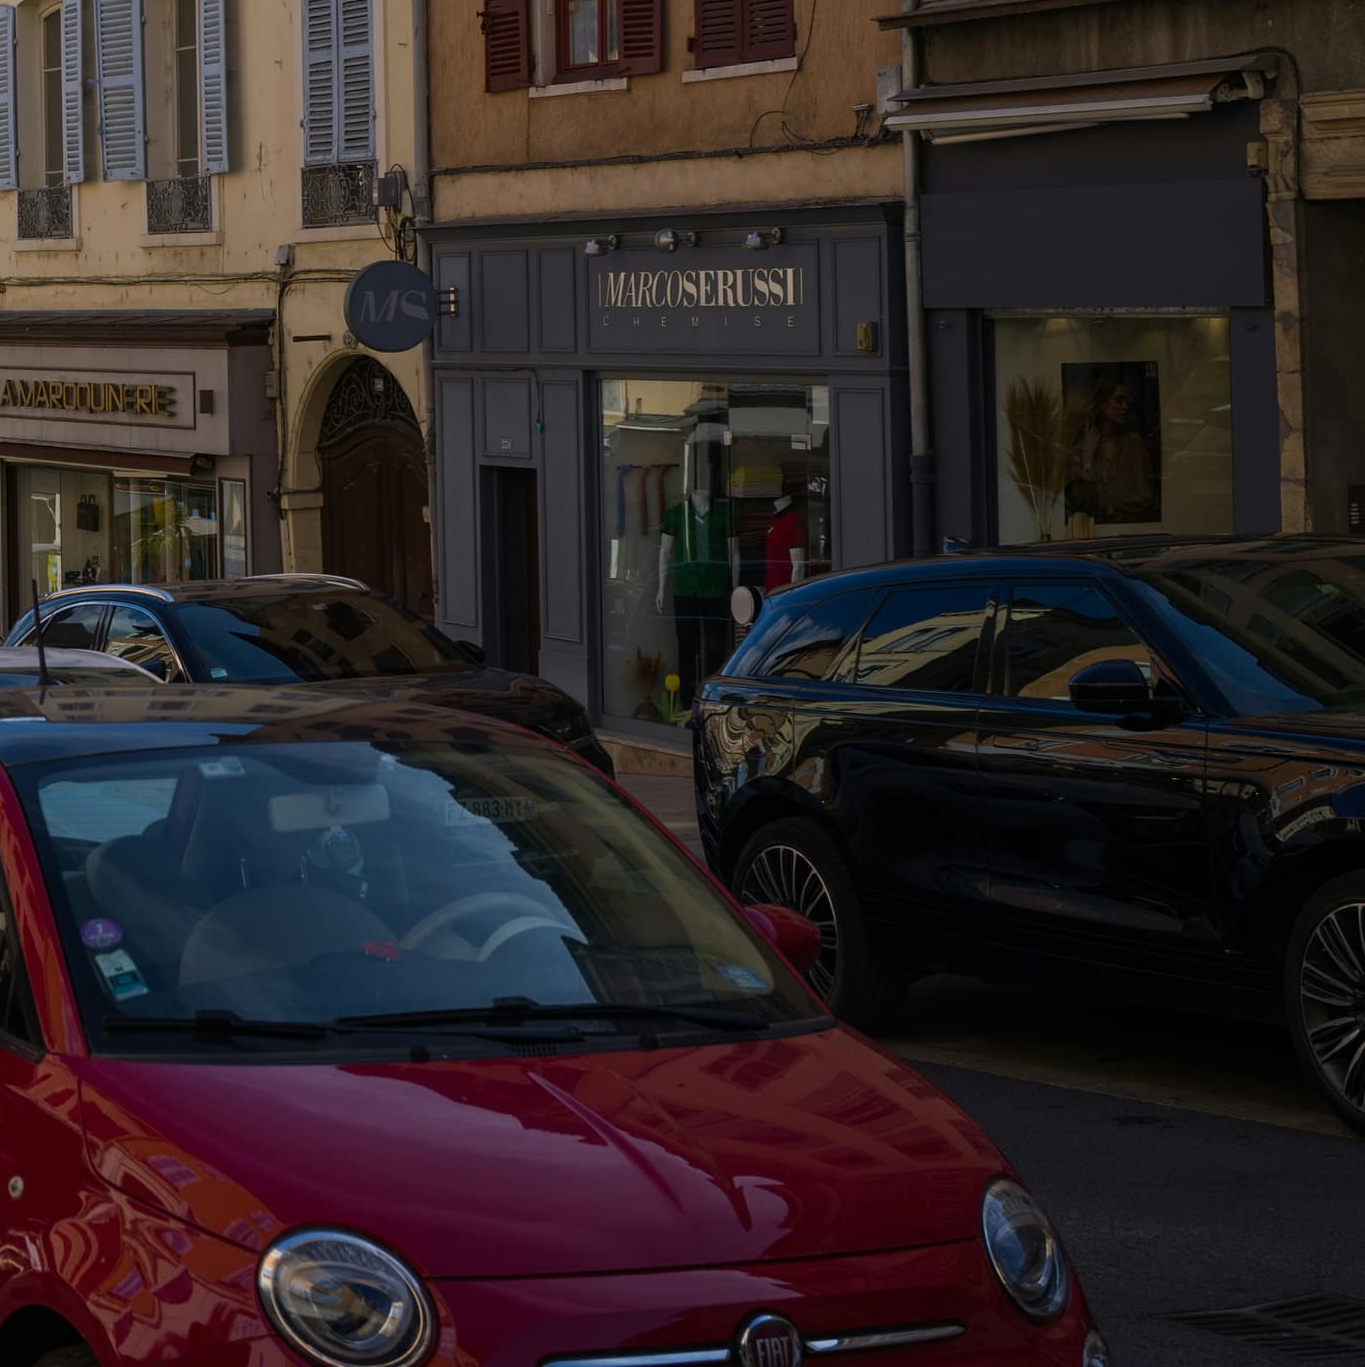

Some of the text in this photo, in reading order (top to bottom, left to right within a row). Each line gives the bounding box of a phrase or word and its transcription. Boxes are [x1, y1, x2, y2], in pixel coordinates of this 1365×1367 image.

[606, 267, 796, 308] MARCOSERUSSI
[355, 289, 430, 323] MS
[18, 379, 177, 418] MAROQUINERIE
[755, 1335, 791, 1367] FIAT
